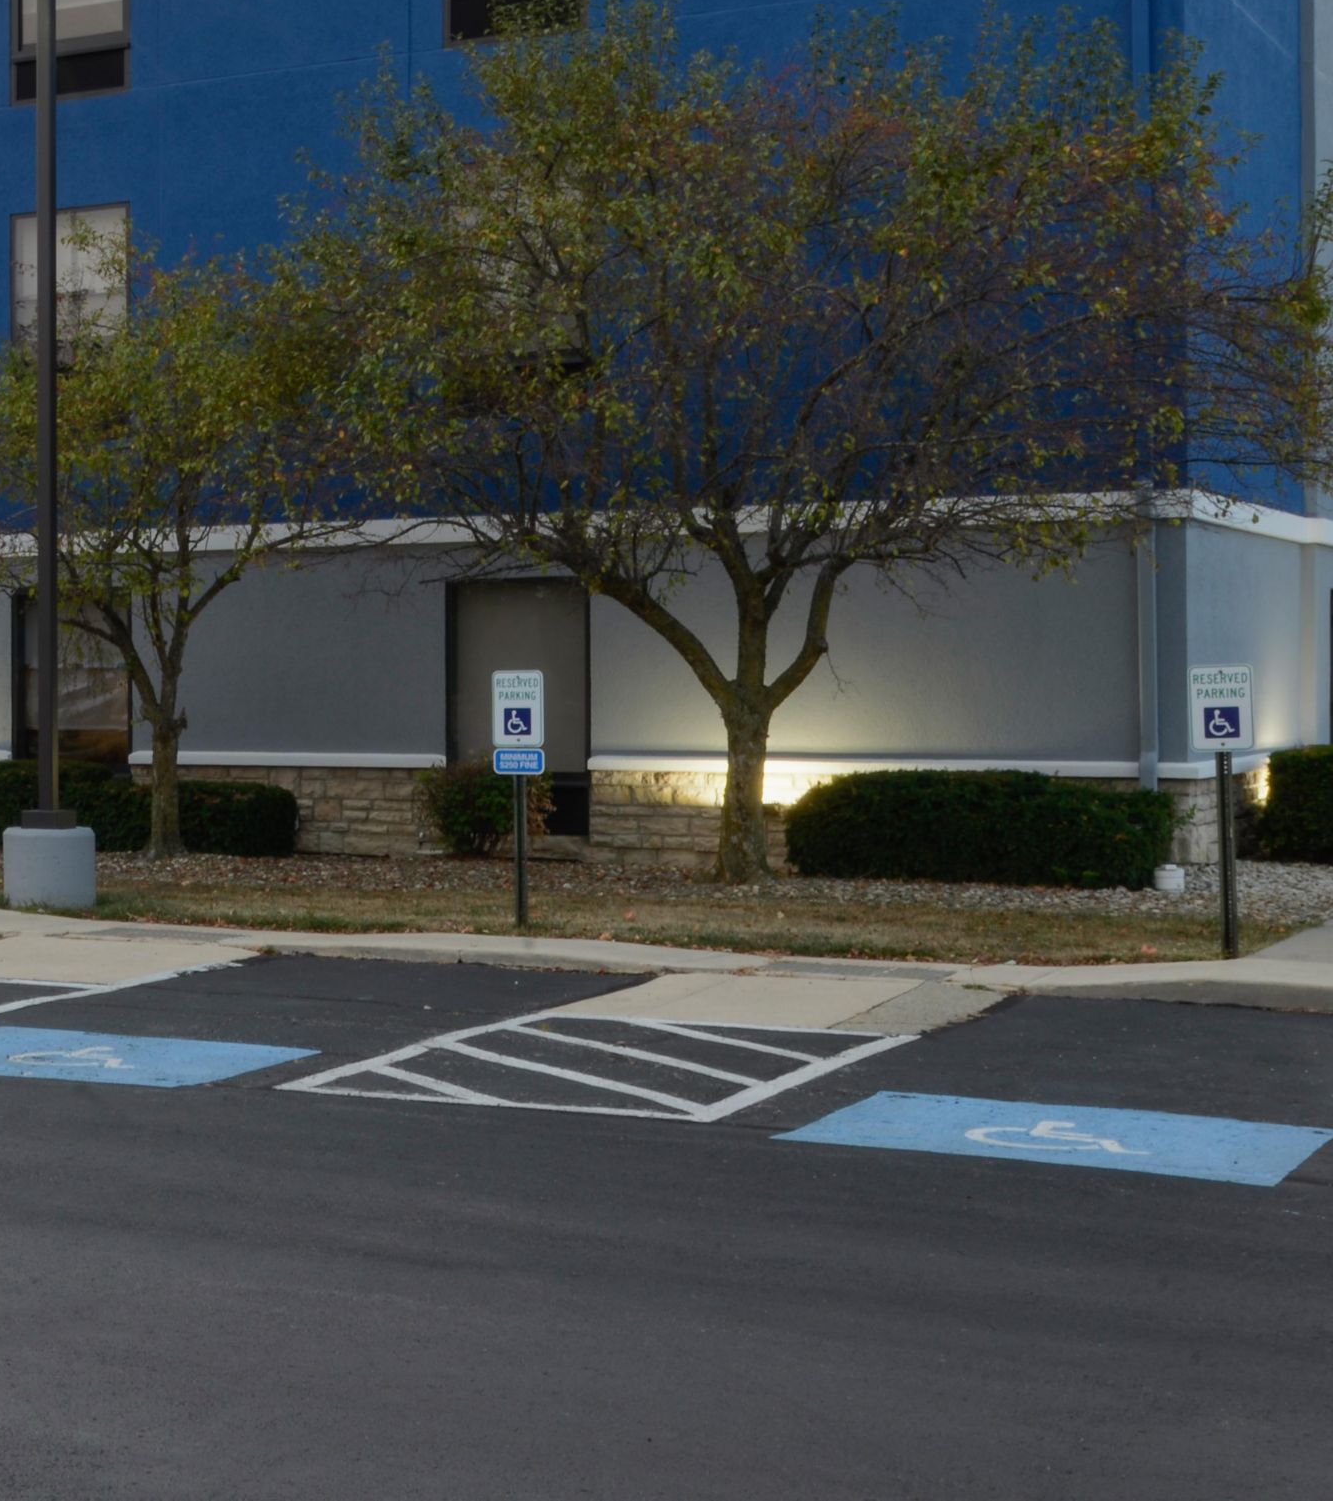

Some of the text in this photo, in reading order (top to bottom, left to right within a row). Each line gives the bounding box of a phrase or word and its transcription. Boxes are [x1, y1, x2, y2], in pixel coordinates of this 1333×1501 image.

[496, 678, 539, 688] RESERVED
[1192, 672, 1248, 685] RESERVED
[499, 691, 537, 701] PARKING
[1196, 687, 1246, 699] PARKING
